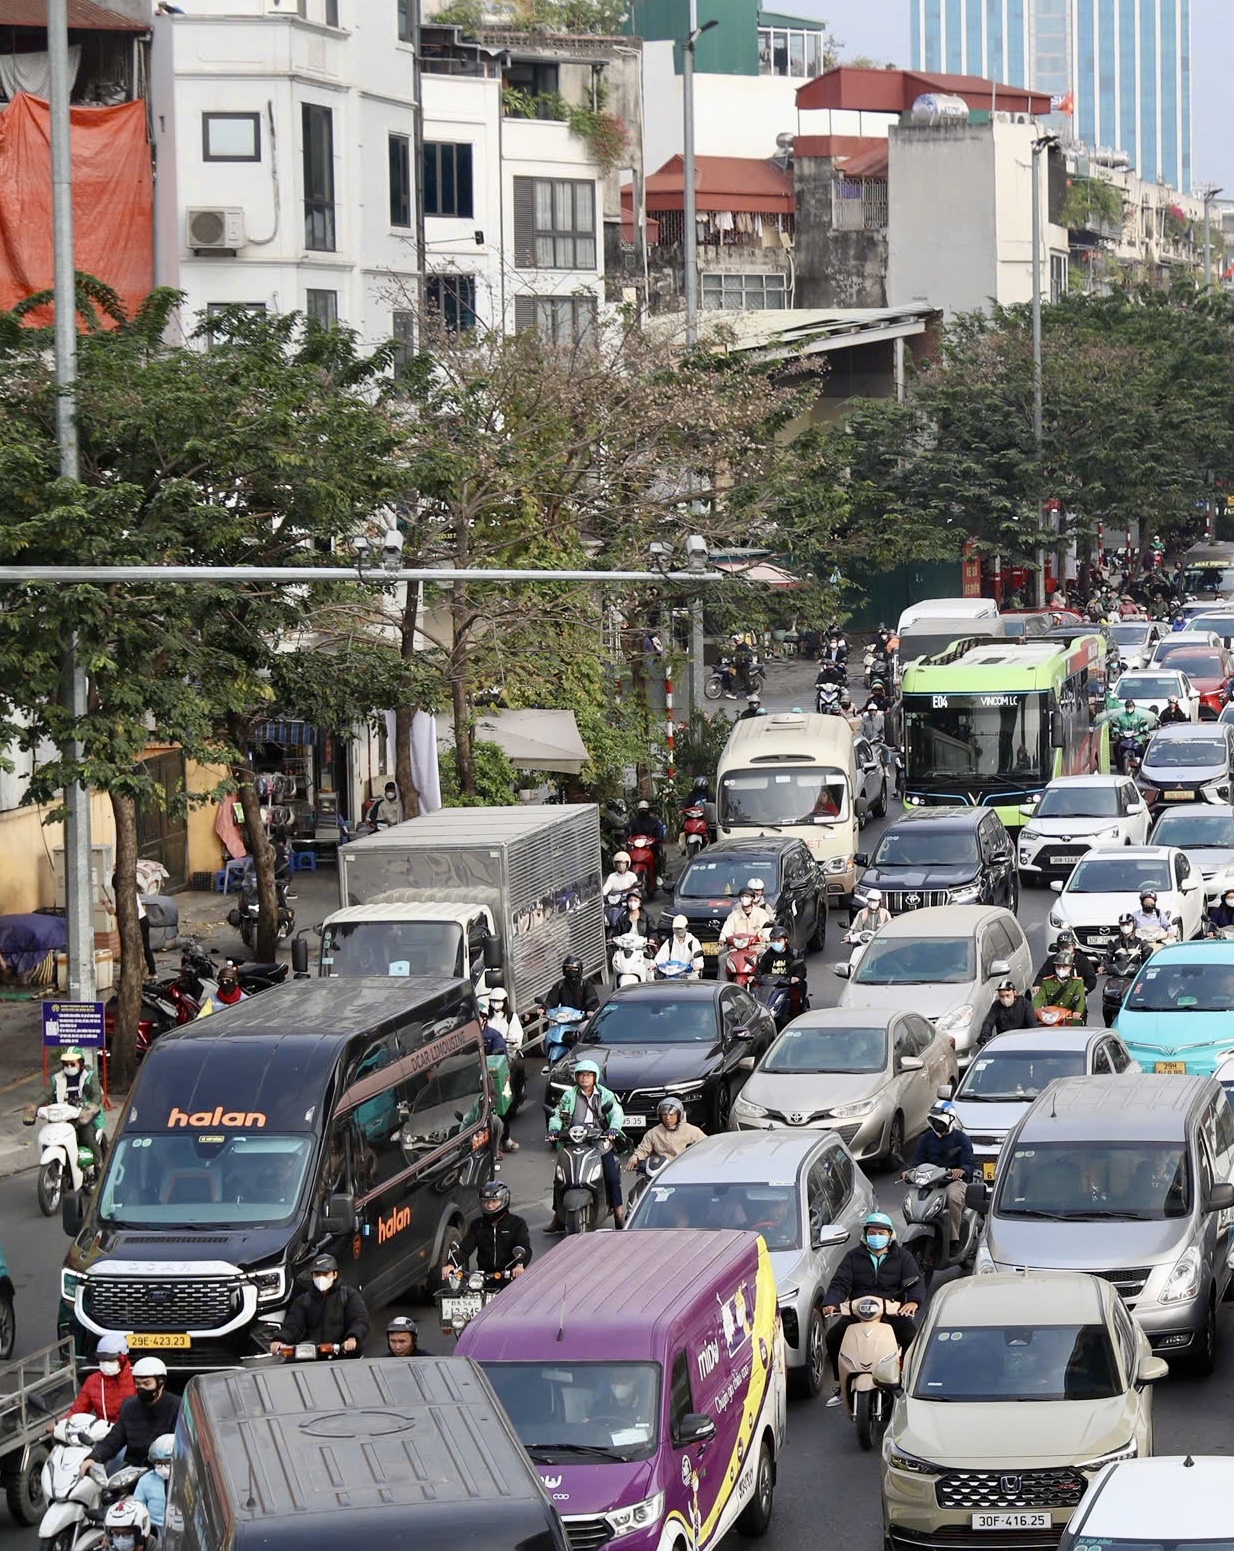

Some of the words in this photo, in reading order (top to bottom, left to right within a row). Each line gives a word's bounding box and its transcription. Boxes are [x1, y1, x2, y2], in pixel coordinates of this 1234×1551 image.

[932, 695, 948, 708] E04
[980, 697, 1008, 706] VINCOM
[1009, 696, 1018, 705] LC
[430, 1031, 466, 1061] LIMOUSINE
[168, 1107, 267, 1128] halan
[378, 1206, 411, 1244] halan
[131, 1336, 186, 1347] 29E-423.23
[978, 1515, 1046, 1527] 30F-416.25
